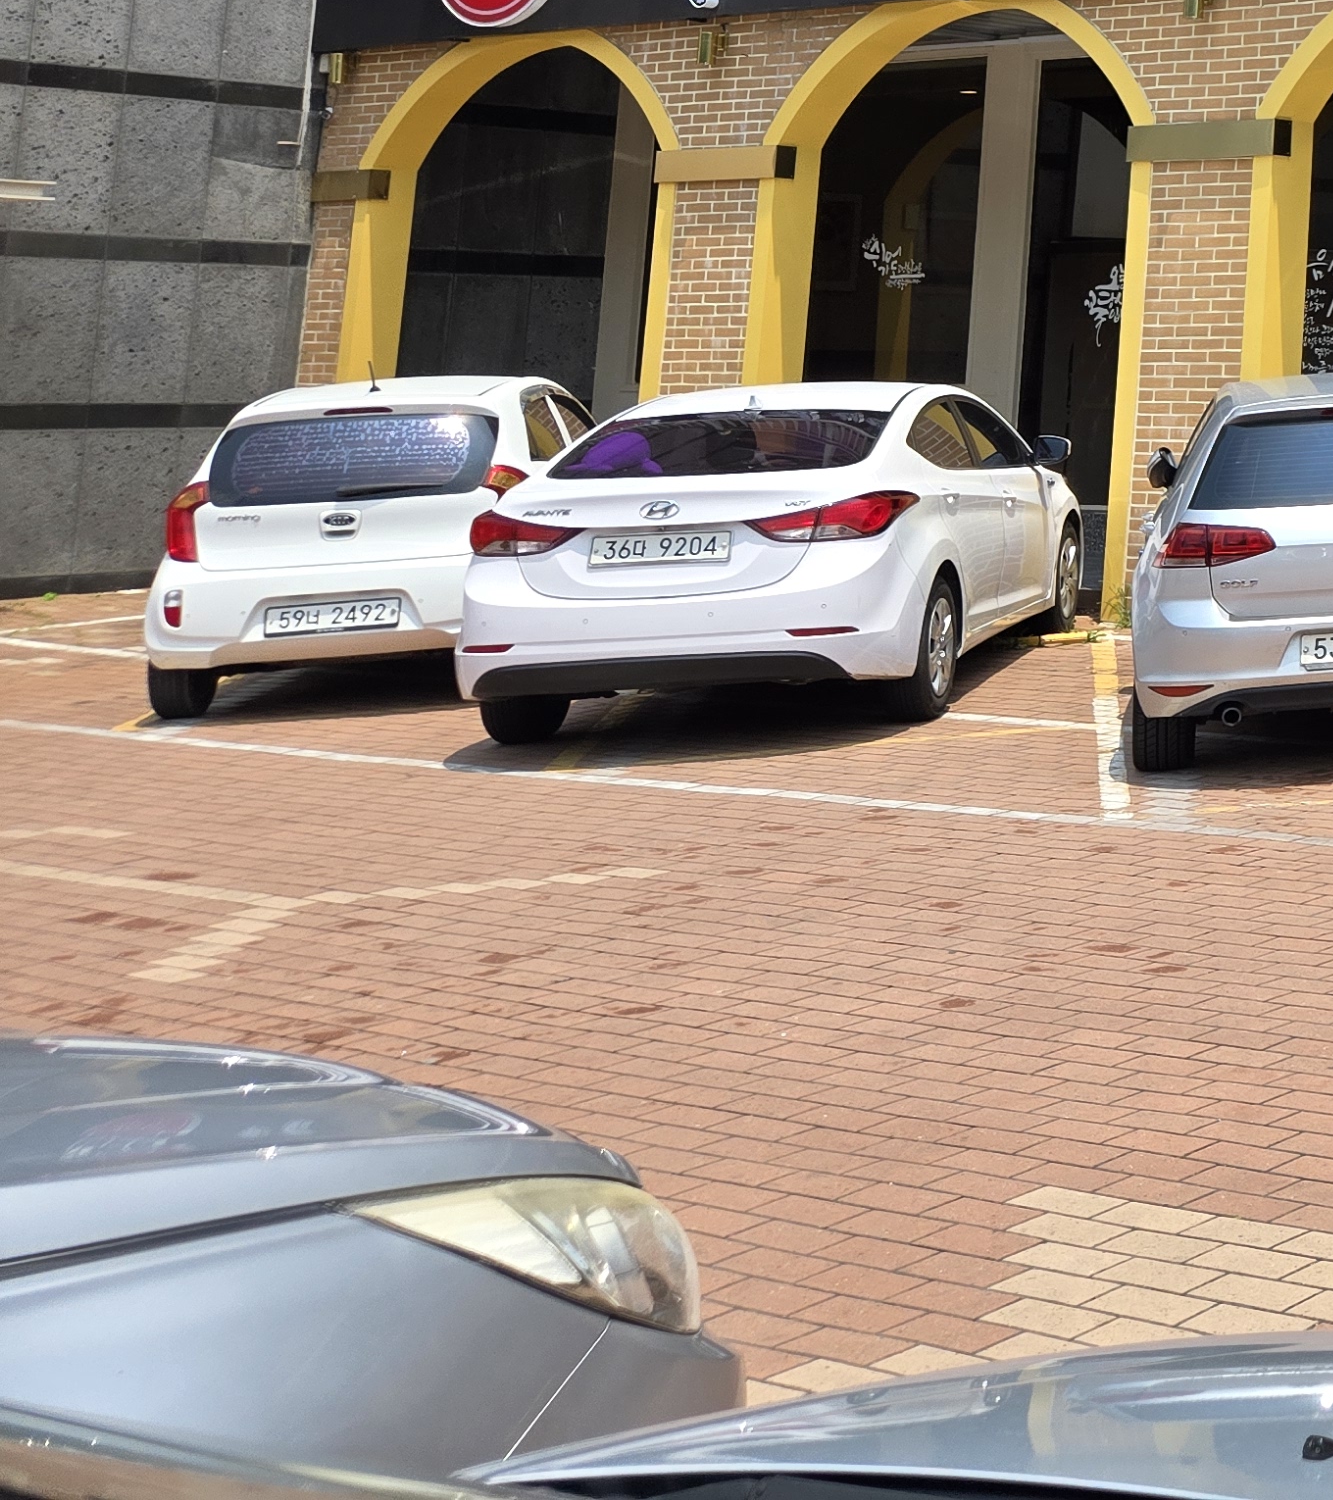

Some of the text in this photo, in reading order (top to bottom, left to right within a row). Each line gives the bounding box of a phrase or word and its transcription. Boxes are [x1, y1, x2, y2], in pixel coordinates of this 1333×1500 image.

[522, 508, 573, 518] AVANTE
[217, 514, 261, 524] morning
[603, 536, 717, 561] 36다 9204
[1220, 580, 1259, 590] GOLF
[331, 603, 387, 625] 2492
